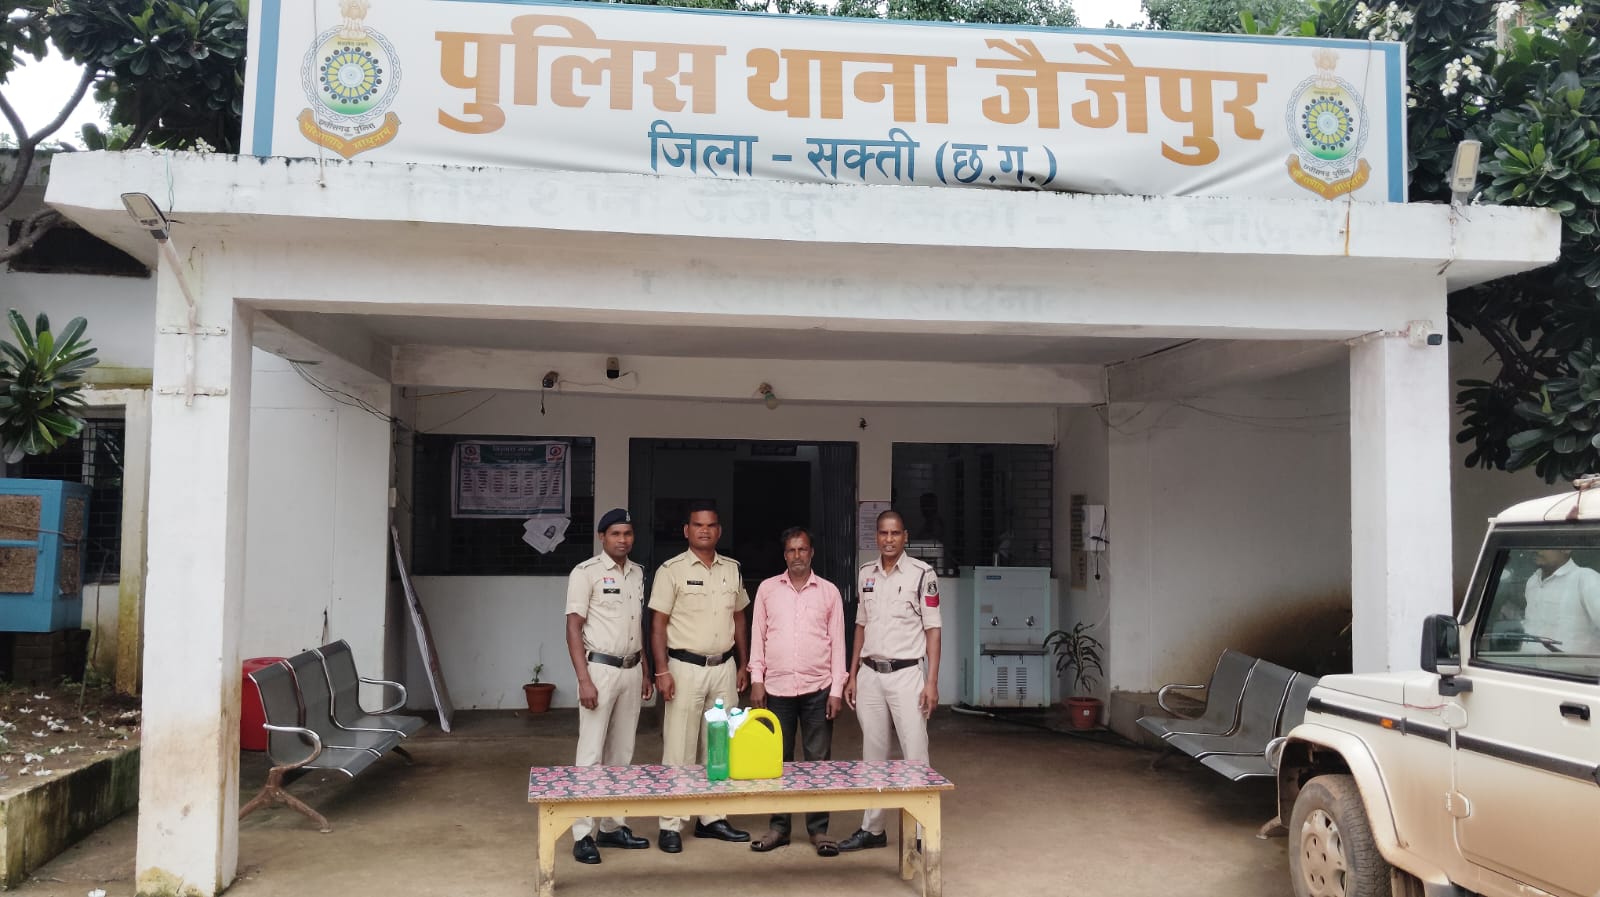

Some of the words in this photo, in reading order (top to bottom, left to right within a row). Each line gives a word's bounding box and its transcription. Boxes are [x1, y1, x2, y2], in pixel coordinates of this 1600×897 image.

[435, 14, 727, 134] पुलिस
[745, 48, 958, 124] थाना
[976, 38, 1268, 166] जैजैपुर
[647, 120, 758, 177] जिला
[806, 128, 920, 180] सक्ती
[935, 139, 1058, 187] (छ.ग.)
